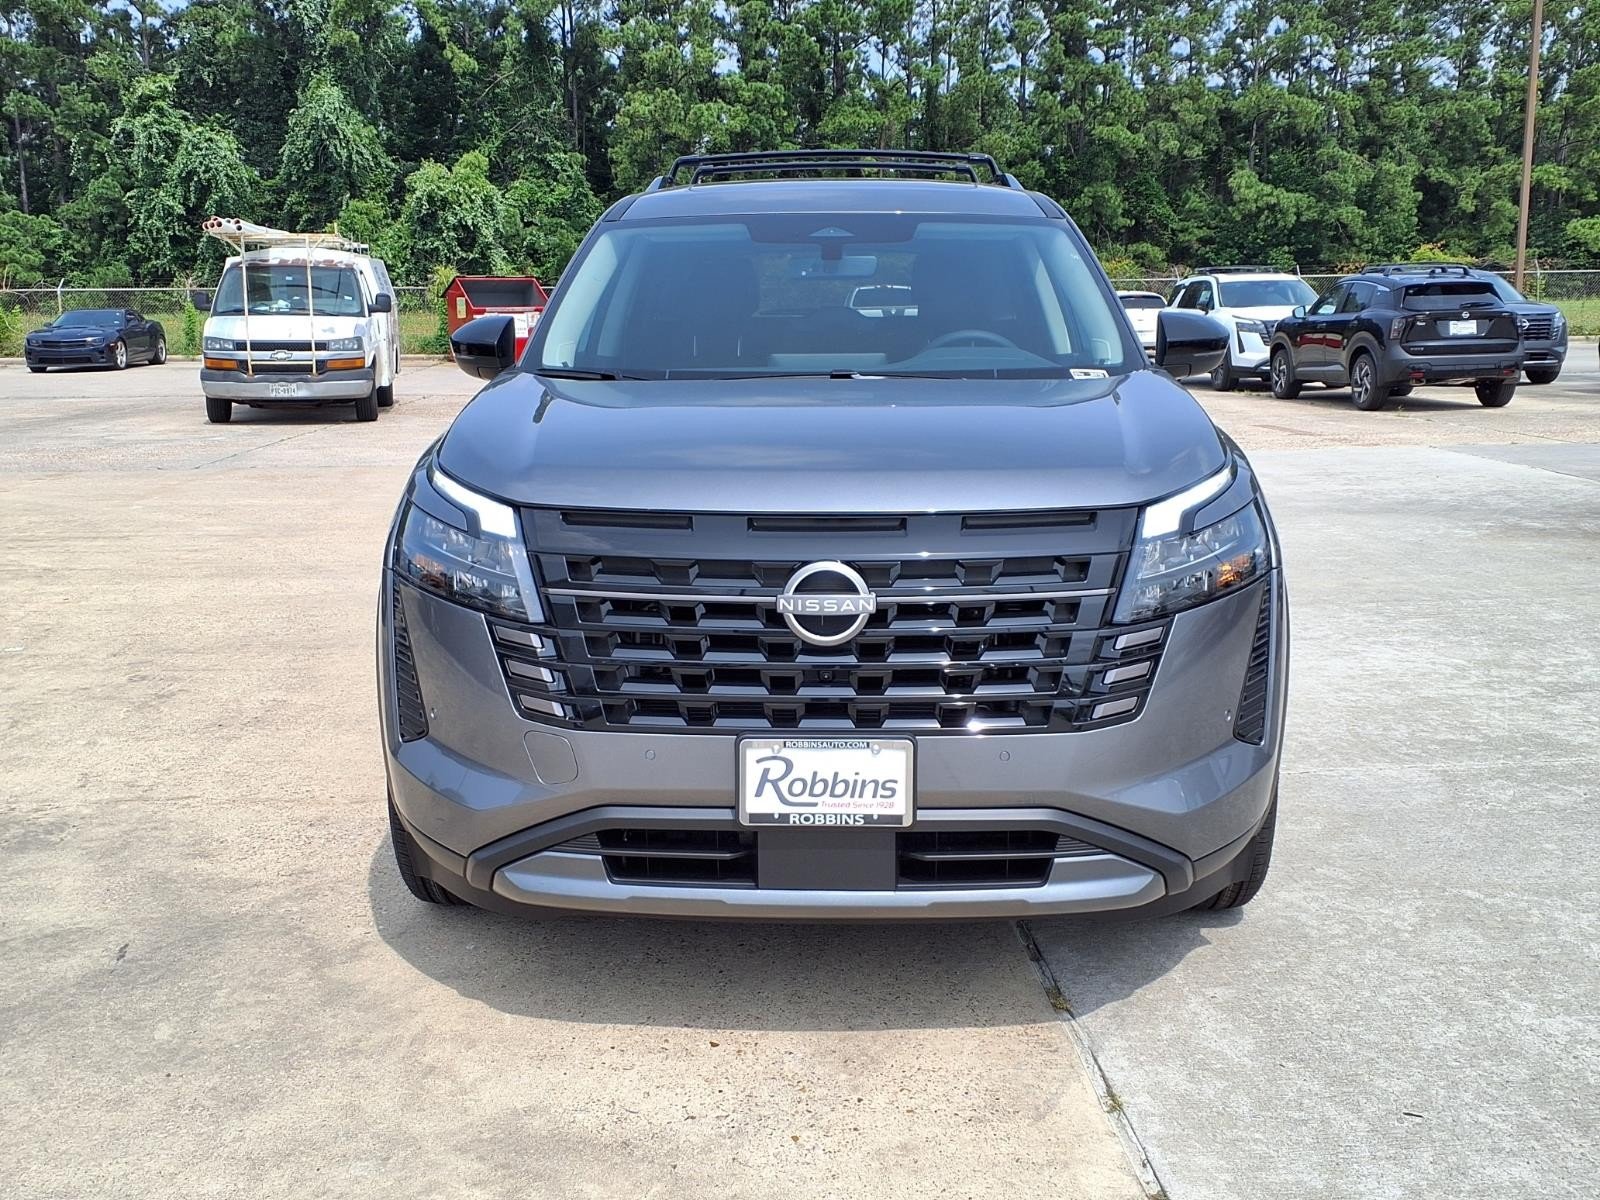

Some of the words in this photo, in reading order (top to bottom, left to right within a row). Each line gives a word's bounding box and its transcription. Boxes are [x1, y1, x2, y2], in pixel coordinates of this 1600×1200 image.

[779, 598, 873, 611] NISSAN
[754, 755, 898, 807] Robbins
[821, 800, 850, 808] Trusted
[852, 800, 874, 808] Since
[789, 814, 865, 825] ROBBINS
